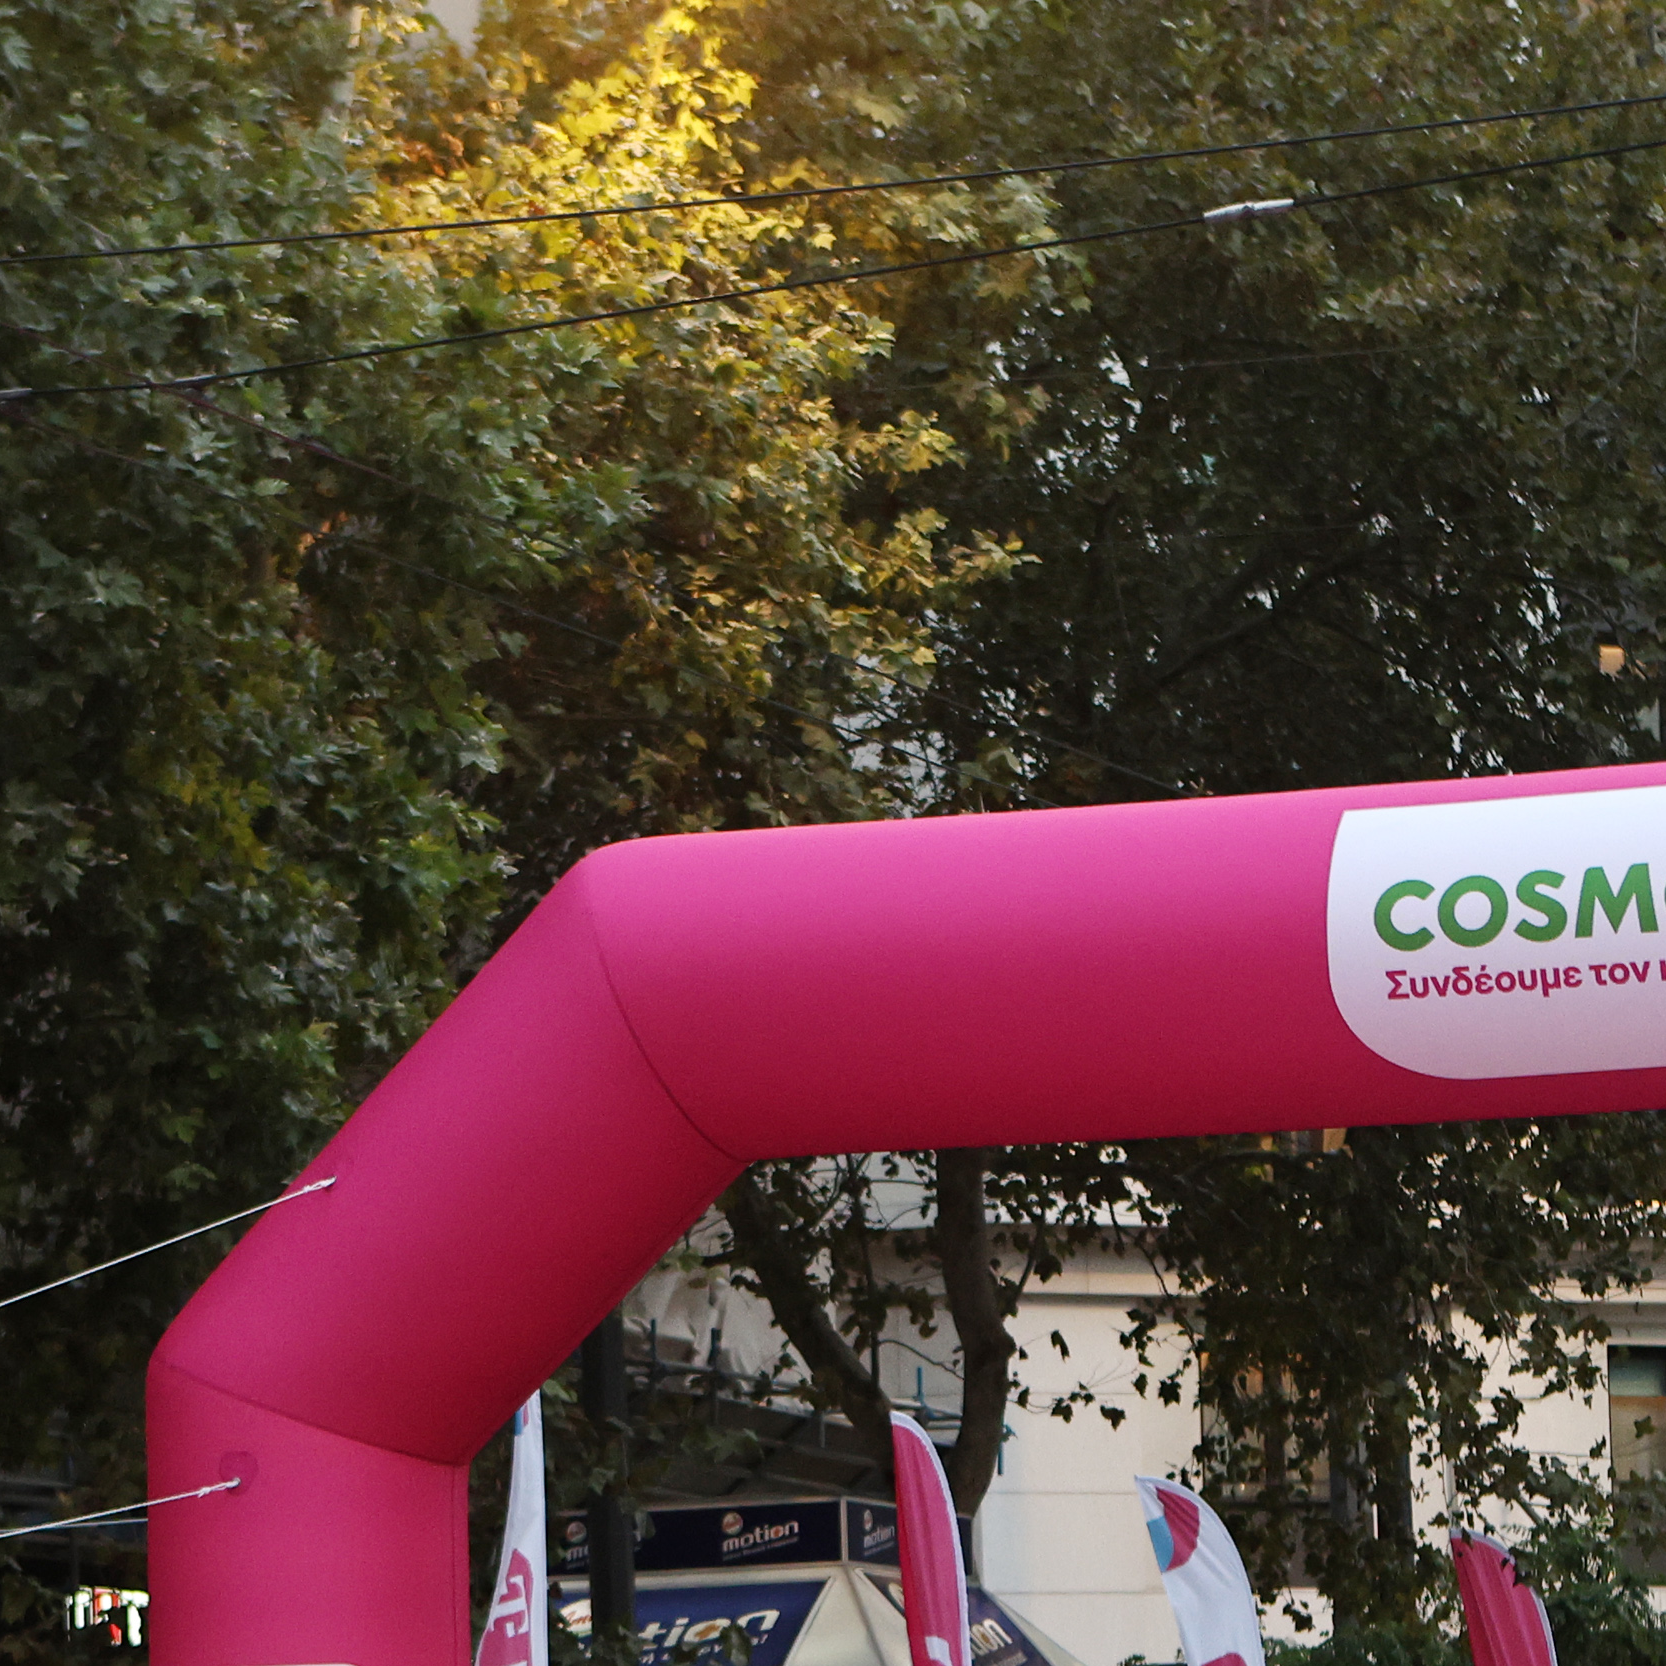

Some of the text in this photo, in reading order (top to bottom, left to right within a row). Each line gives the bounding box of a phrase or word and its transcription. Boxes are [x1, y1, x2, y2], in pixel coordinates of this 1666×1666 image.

[1385, 965, 1583, 1000] Συνδέουμε
[1589, 960, 1651, 983] τον
[722, 1520, 800, 1553] motion
[637, 1608, 781, 1651] tion
